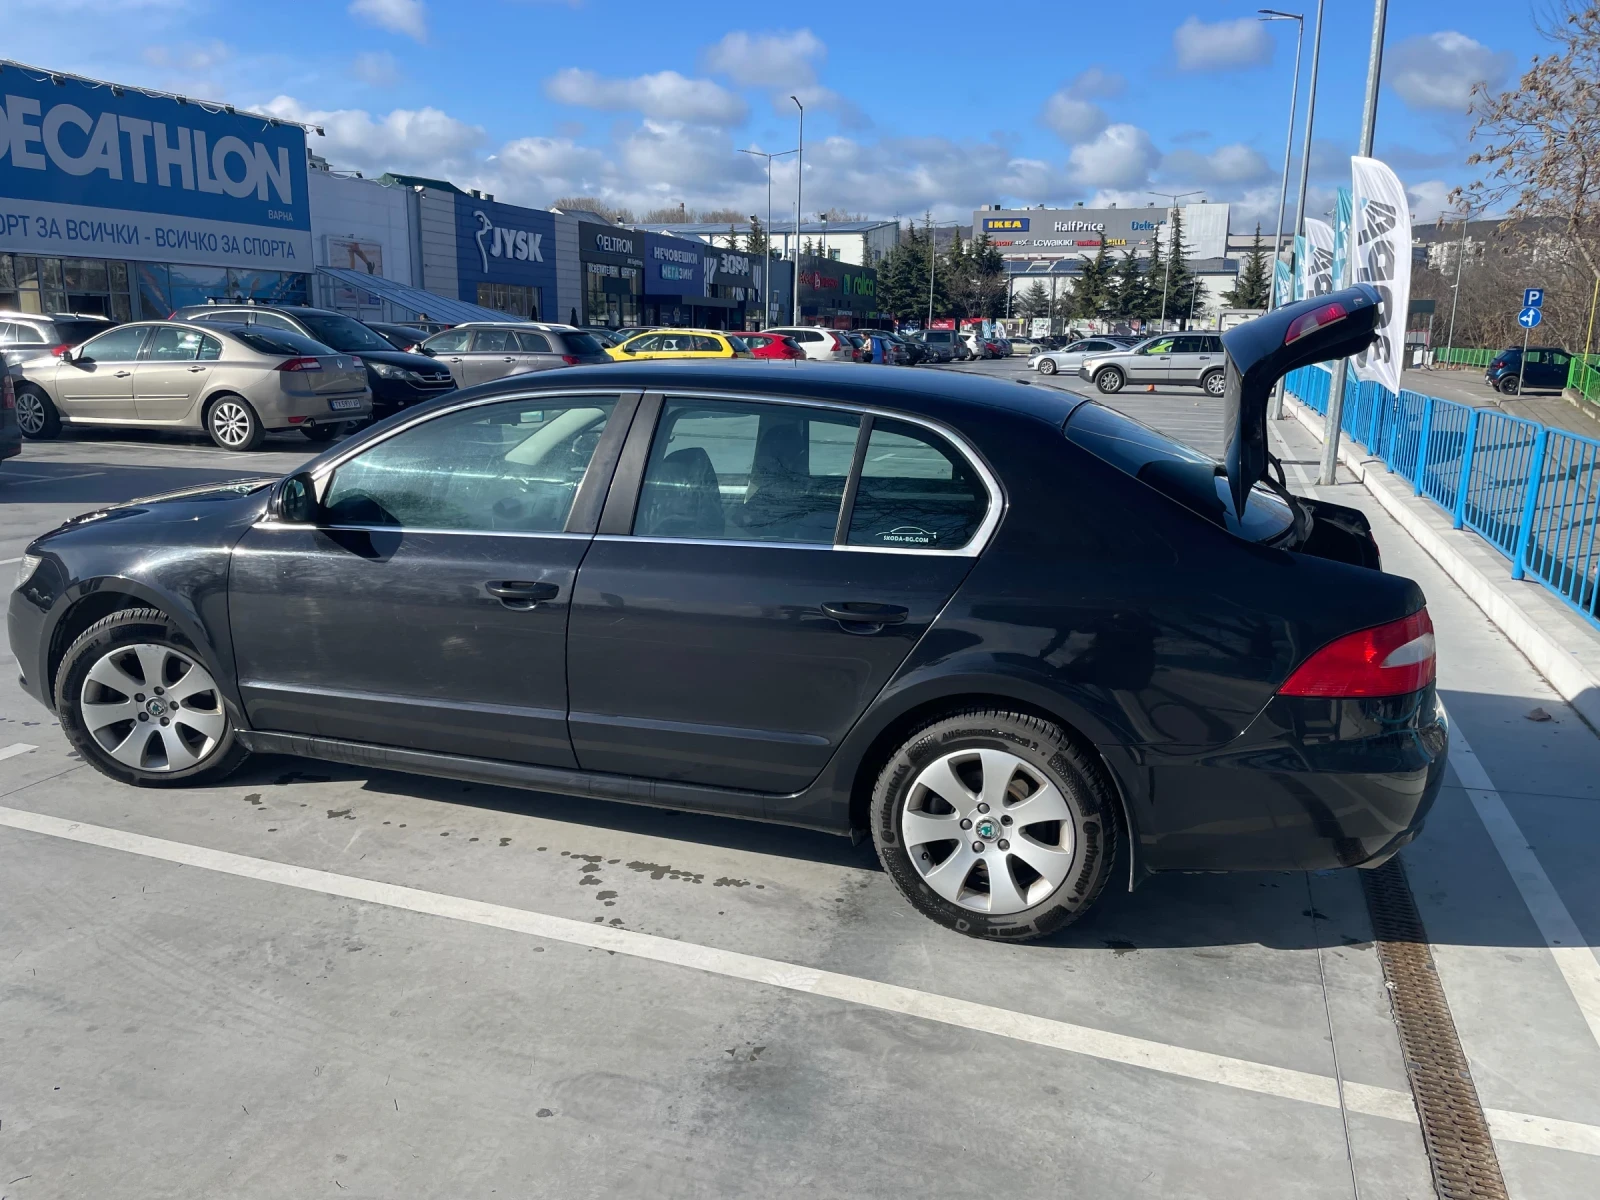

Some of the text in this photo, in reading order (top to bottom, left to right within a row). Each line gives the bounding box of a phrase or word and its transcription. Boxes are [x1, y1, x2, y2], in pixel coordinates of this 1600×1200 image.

[268, 209, 293, 222] ВАРНА
[988, 220, 1022, 229] IKEA
[36, 216, 62, 239] ЗА
[66, 218, 140, 246] ВСИЧКИ
[155, 227, 218, 252] ВСИЧКО
[221, 234, 241, 254] ЗА
[243, 236, 296, 259] СПОРТА
[490, 226, 544, 263] JYSK
[653, 246, 698, 265] НЕЧОВЕШКИ
[719, 253, 750, 276] ЗОРА
[1528, 290, 1540, 305] P
